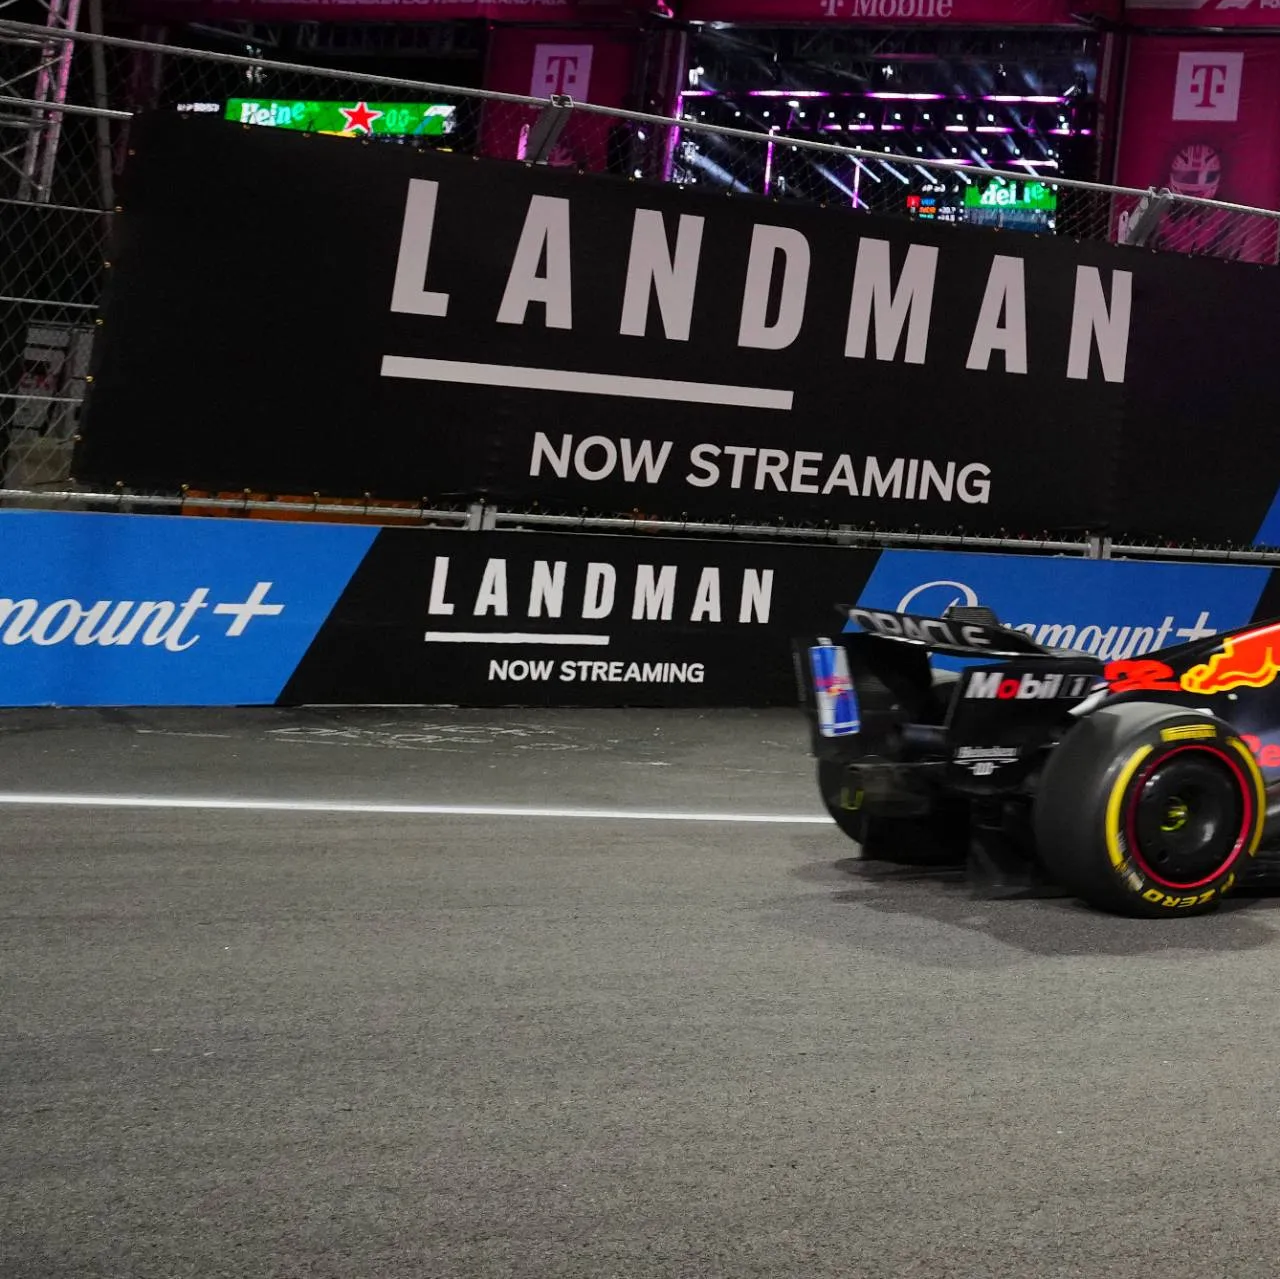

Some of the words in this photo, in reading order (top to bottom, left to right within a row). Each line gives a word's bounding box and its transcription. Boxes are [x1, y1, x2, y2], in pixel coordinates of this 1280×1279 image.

[390, 178, 1132, 383] LANDMAN
[529, 431, 673, 484] NOW
[686, 442, 992, 504] STREAMING
[428, 556, 774, 623] LANDMAN
[488, 659, 554, 682] NOW
[559, 660, 704, 683] STREAMING
[964, 672, 1063, 699] Mobil
[1070, 677, 1085, 697] 1
